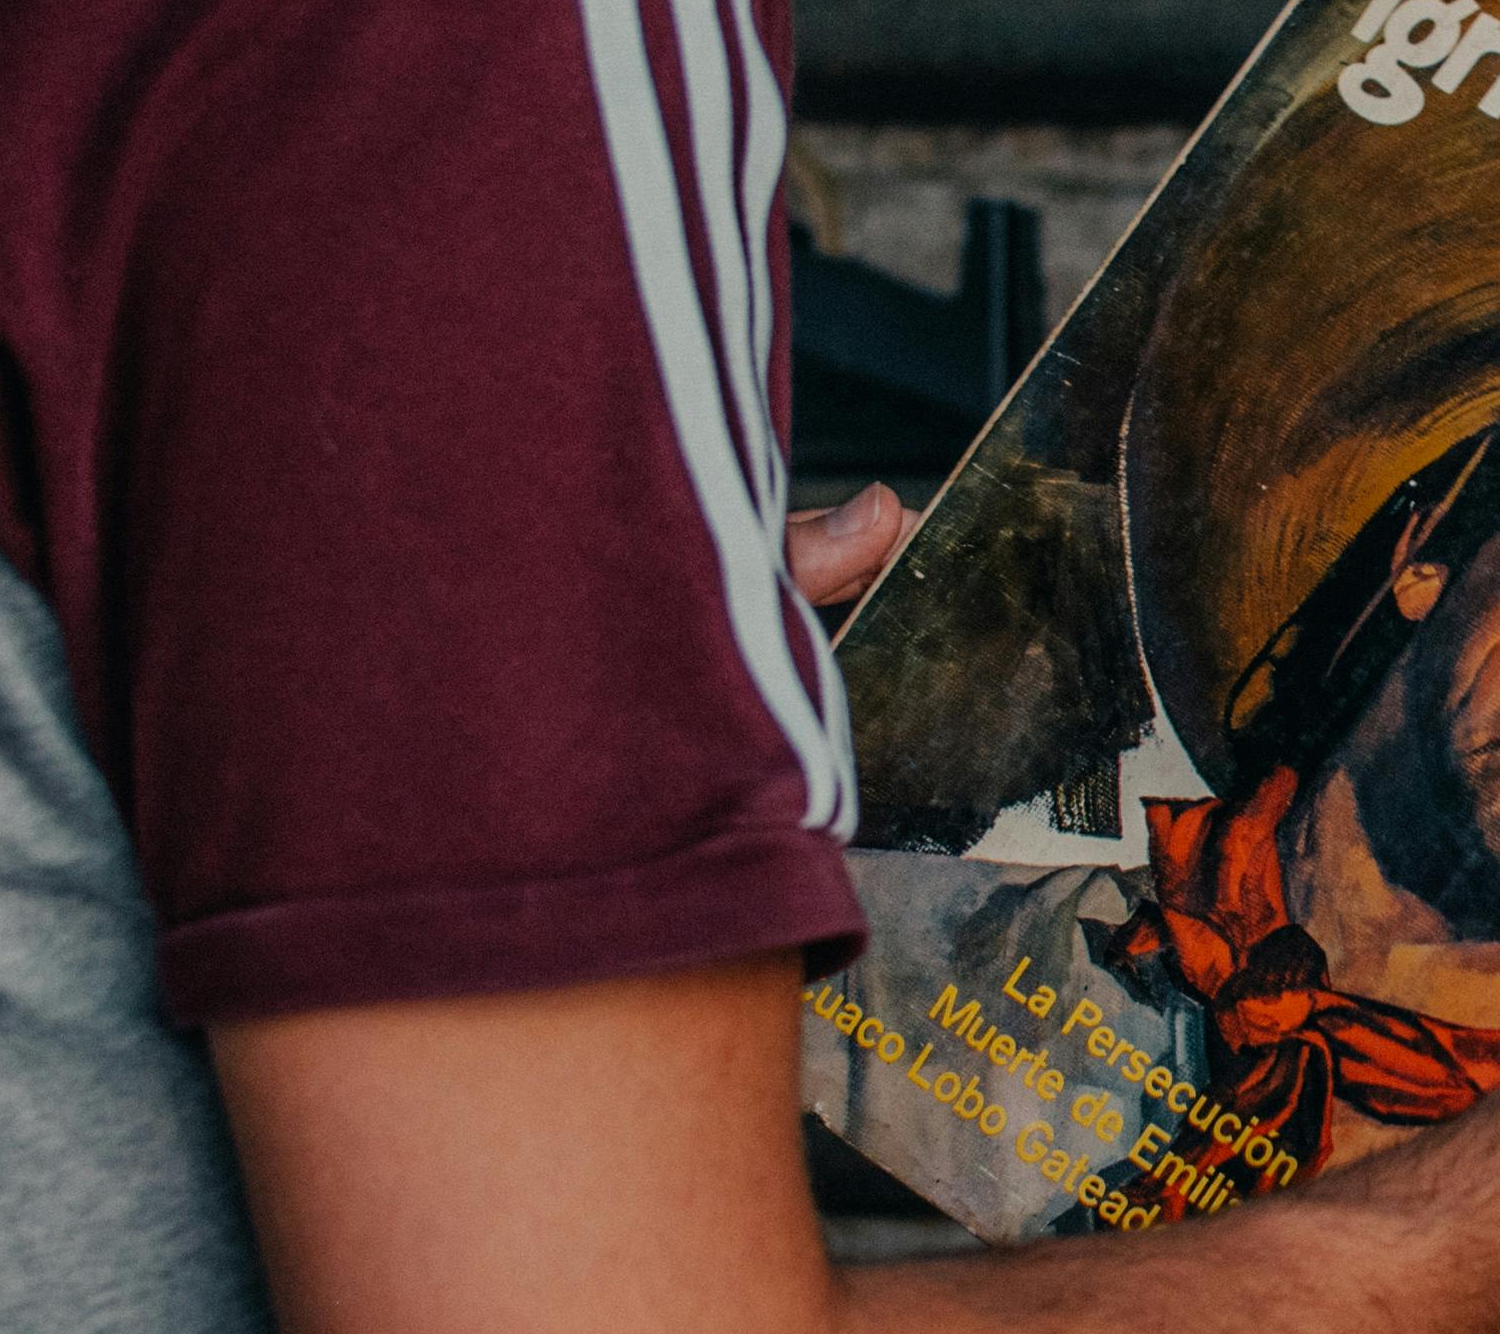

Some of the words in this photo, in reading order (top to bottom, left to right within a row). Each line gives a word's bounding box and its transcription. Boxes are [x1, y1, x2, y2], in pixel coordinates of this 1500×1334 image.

[906, 1044, 1008, 1138] Lobo
[1014, 1120, 1165, 1234] Gatead
[928, 984, 1066, 1101] Muerte
[1071, 1087, 1124, 1142] de
[1129, 1122, 1246, 1217] Emili
[1003, 956, 1057, 1019] La
[1061, 996, 1299, 1186] Persecución
